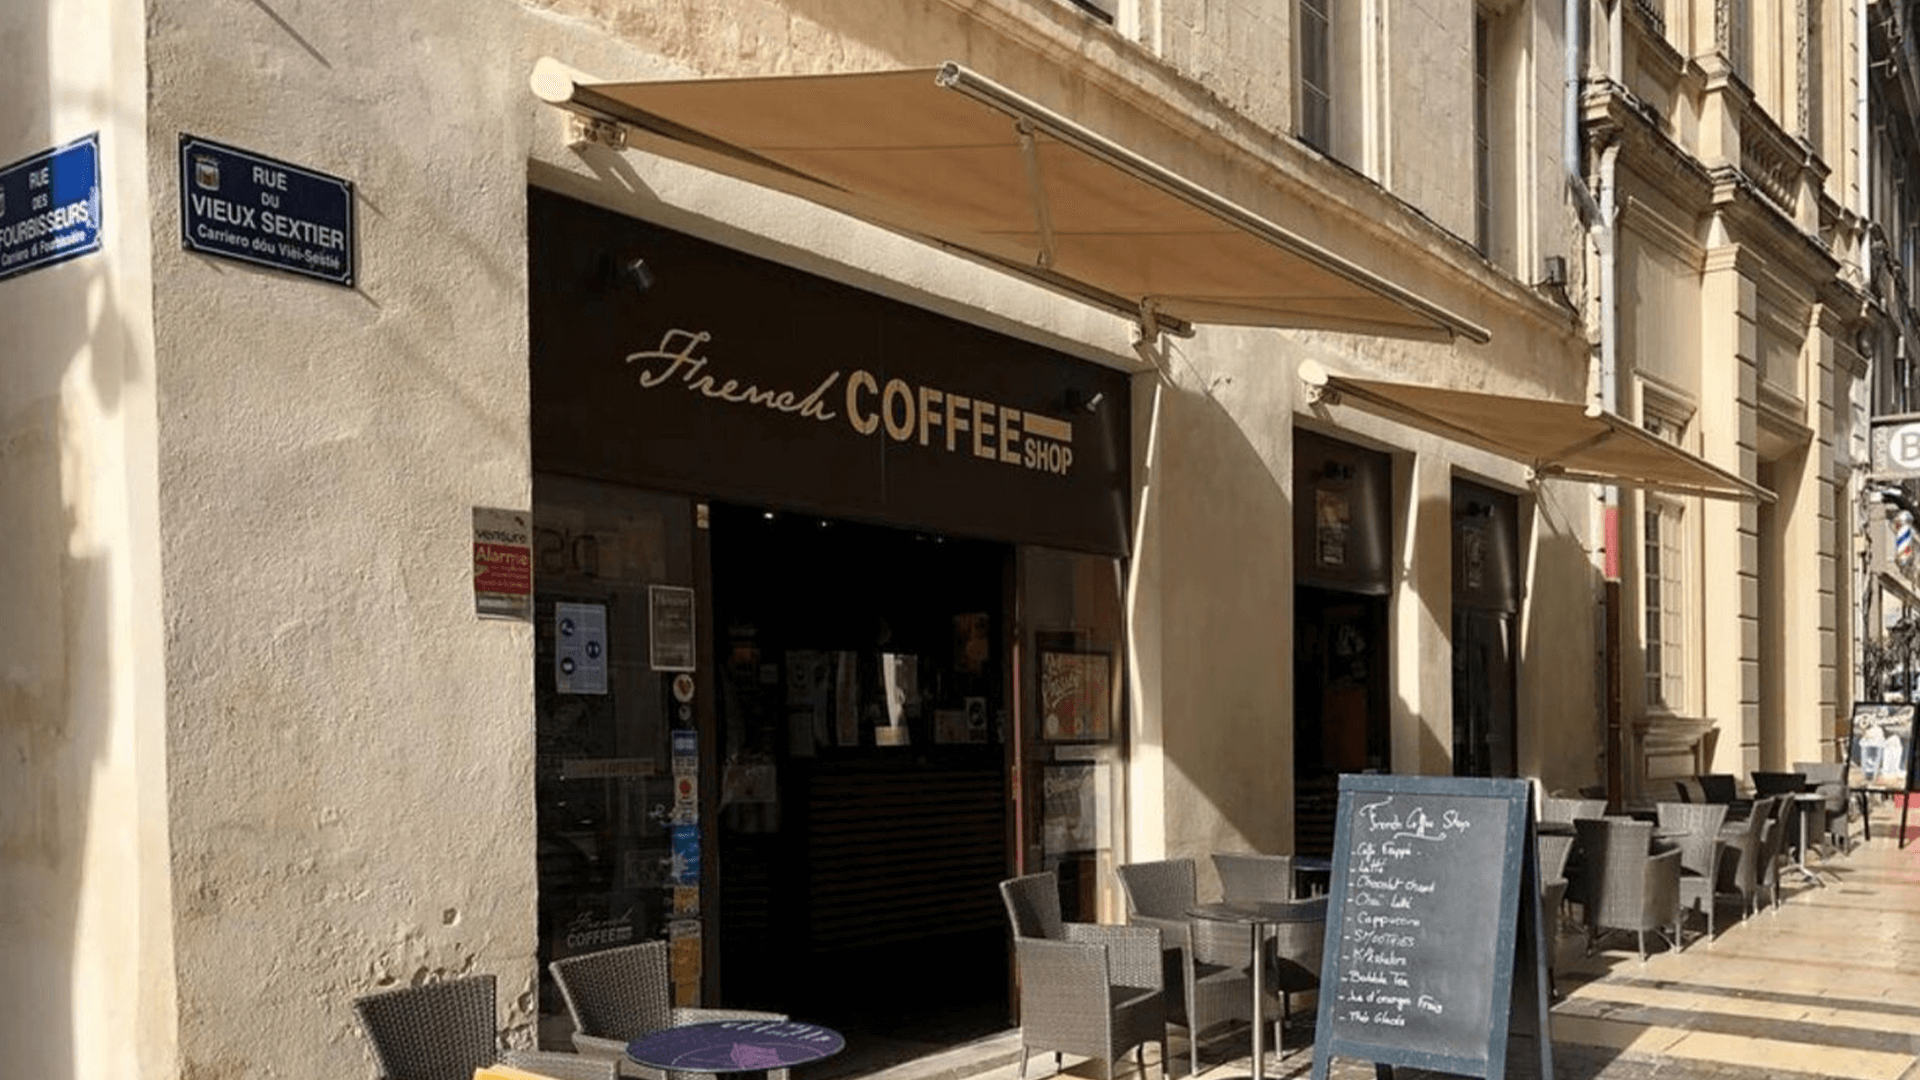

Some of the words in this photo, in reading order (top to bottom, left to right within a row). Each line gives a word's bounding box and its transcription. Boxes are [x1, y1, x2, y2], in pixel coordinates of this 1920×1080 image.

[28, 166, 50, 190] RUE
[252, 165, 288, 191] RUE
[31, 193, 48, 211] DES
[260, 192, 280, 208] DU
[190, 193, 257, 230] VIEUX
[260, 211, 345, 252] SEXTIER
[197, 224, 250, 247] Carriero
[626, 328, 841, 422] French
[846, 369, 1021, 466] COFFEE
[1023, 437, 1073, 475] SHOP
[475, 545, 528, 566] Alarme
[1359, 796, 1403, 832] French
[567, 928, 616, 948] COFFEE
